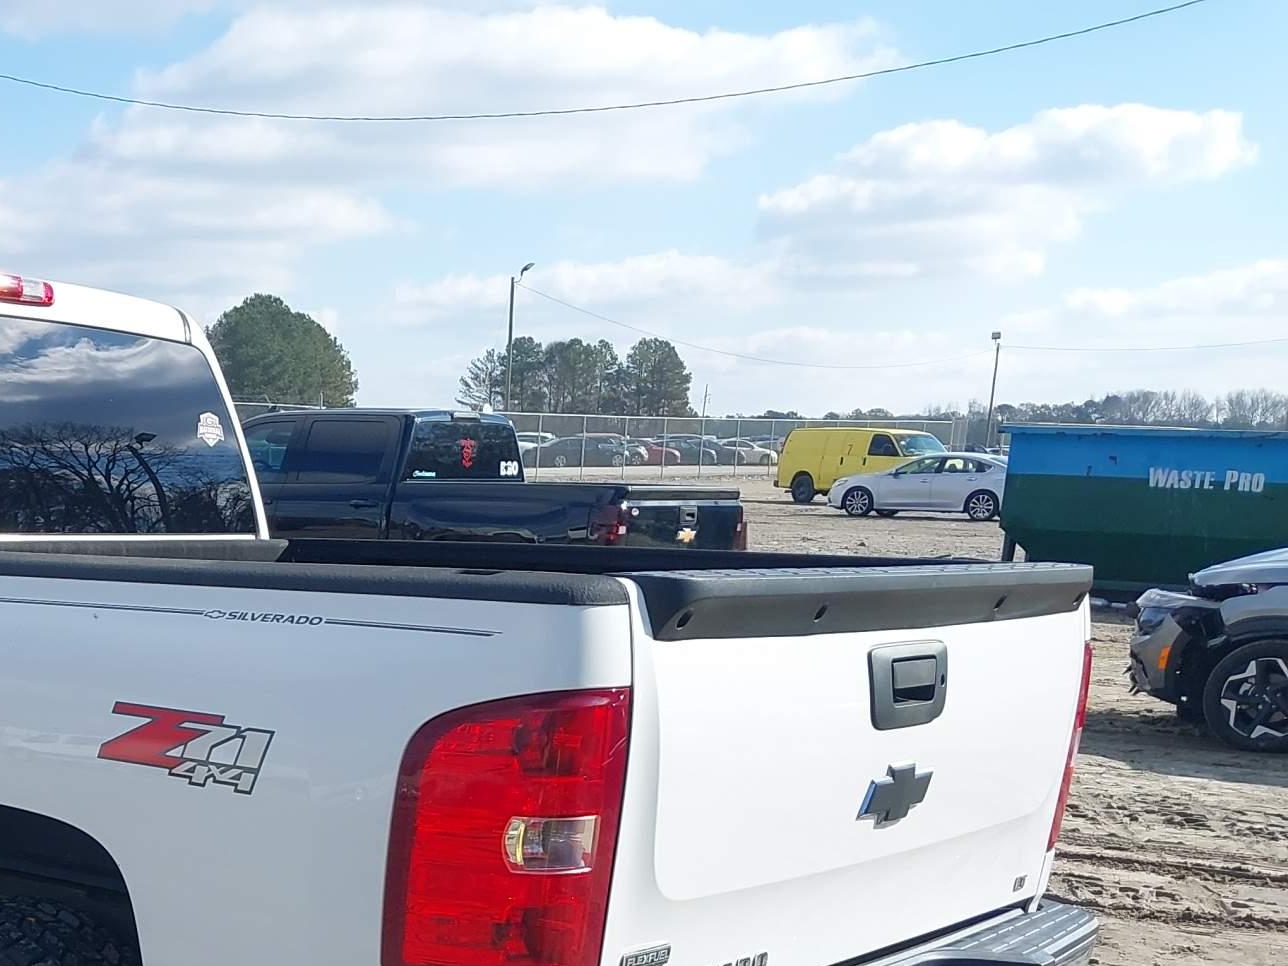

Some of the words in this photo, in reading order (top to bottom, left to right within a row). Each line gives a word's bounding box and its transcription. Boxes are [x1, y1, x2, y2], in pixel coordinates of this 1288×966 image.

[1148, 467, 1216, 489] WASTE
[1223, 470, 1266, 493] PRO
[225, 611, 323, 626] SILVERADO
[97, 700, 276, 771] Z71
